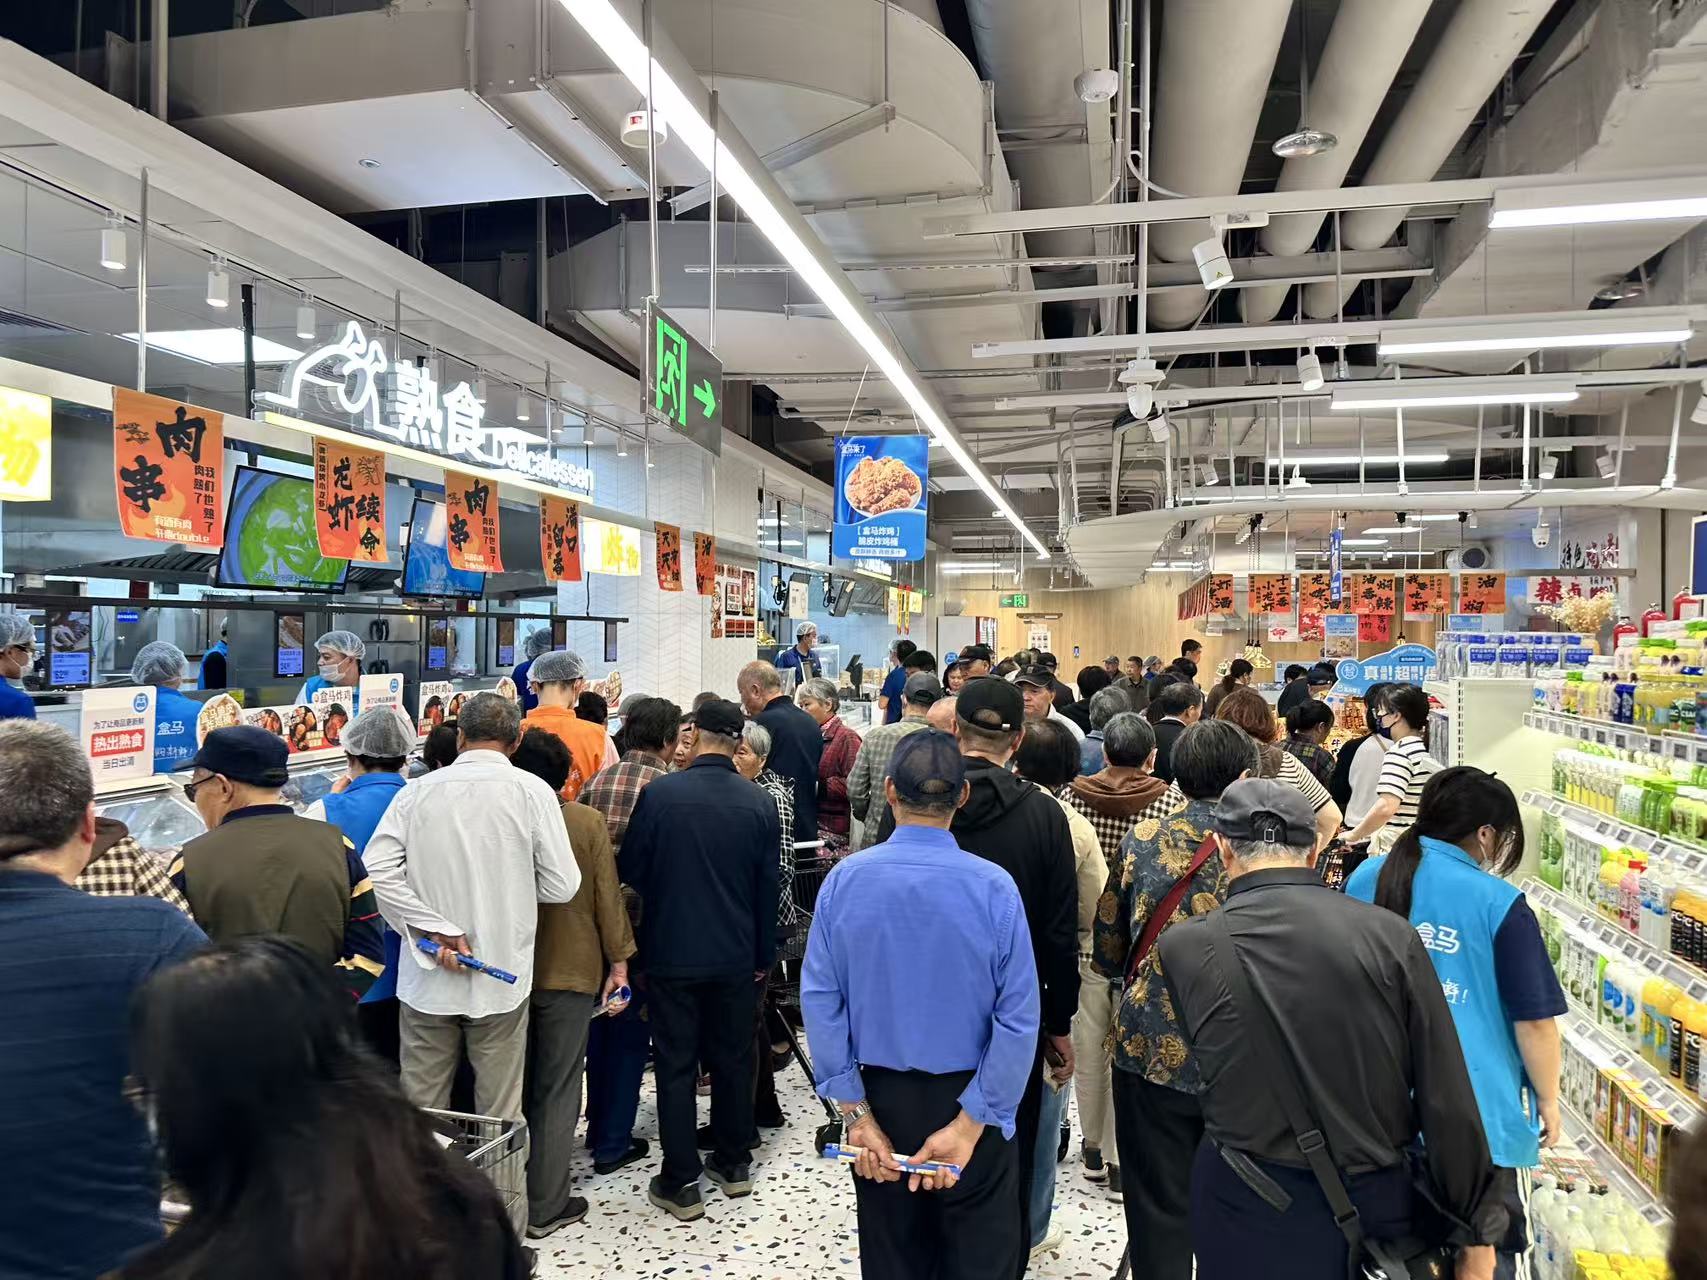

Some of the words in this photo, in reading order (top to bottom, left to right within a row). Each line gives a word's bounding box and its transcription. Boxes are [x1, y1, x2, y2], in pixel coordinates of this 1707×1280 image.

[395, 359, 486, 461] 熟食
[492, 437, 594, 492] Delicatessen
[193, 465, 204, 505] 肉熟了
[203, 466, 215, 534] 我们也熟了
[328, 456, 355, 532] 龙虾
[355, 491, 381, 556] 续命
[553, 522, 565, 577] 留香
[1261, 580, 1275, 612] 小龙虾
[1275, 575, 1289, 607] 十三香
[320, 688, 352, 703] 盒马炸鸡
[93, 717, 145, 730] 为了让商品更新鲜
[157, 720, 185, 736] 盒马
[93, 732, 143, 753] 热出熟食
[102, 756, 135, 770] 当日出清
[1416, 921, 1460, 954] 盒马
